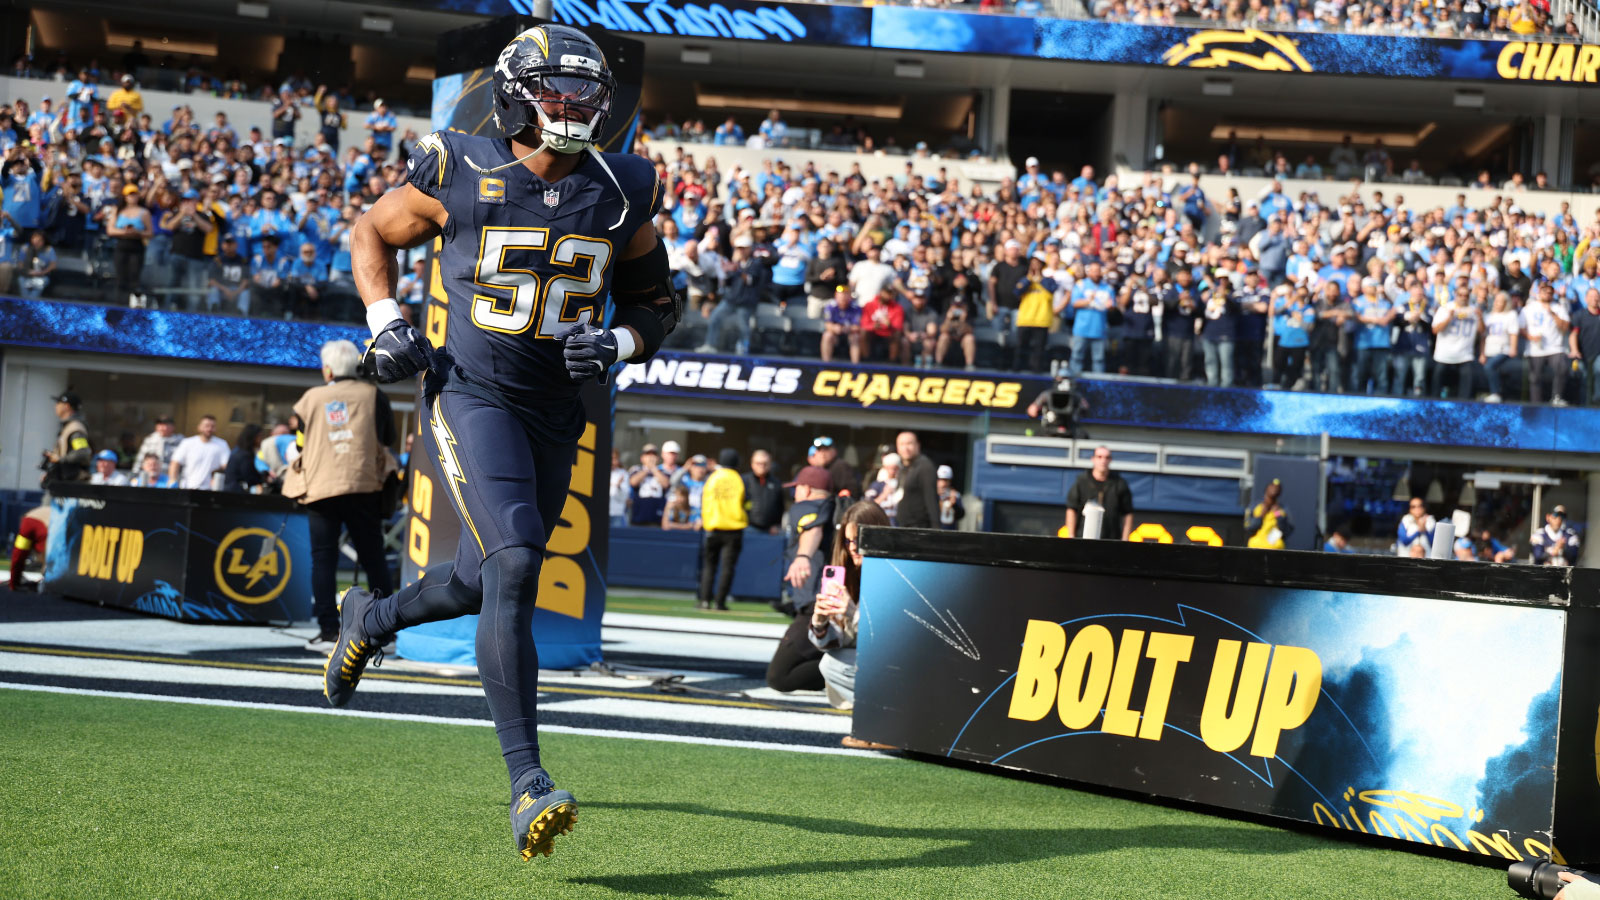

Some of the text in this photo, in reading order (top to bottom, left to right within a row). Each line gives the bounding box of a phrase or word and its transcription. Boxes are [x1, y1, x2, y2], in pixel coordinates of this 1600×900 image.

[480, 177, 504, 197] C
[471, 225, 613, 339] 52
[616, 359, 1022, 408] ANGELES CHARGERS
[77, 524, 144, 584] BOLT UP
[408, 469, 433, 586] OS
[227, 548, 279, 590] LA
[1008, 619, 1323, 759] BOLT UP
